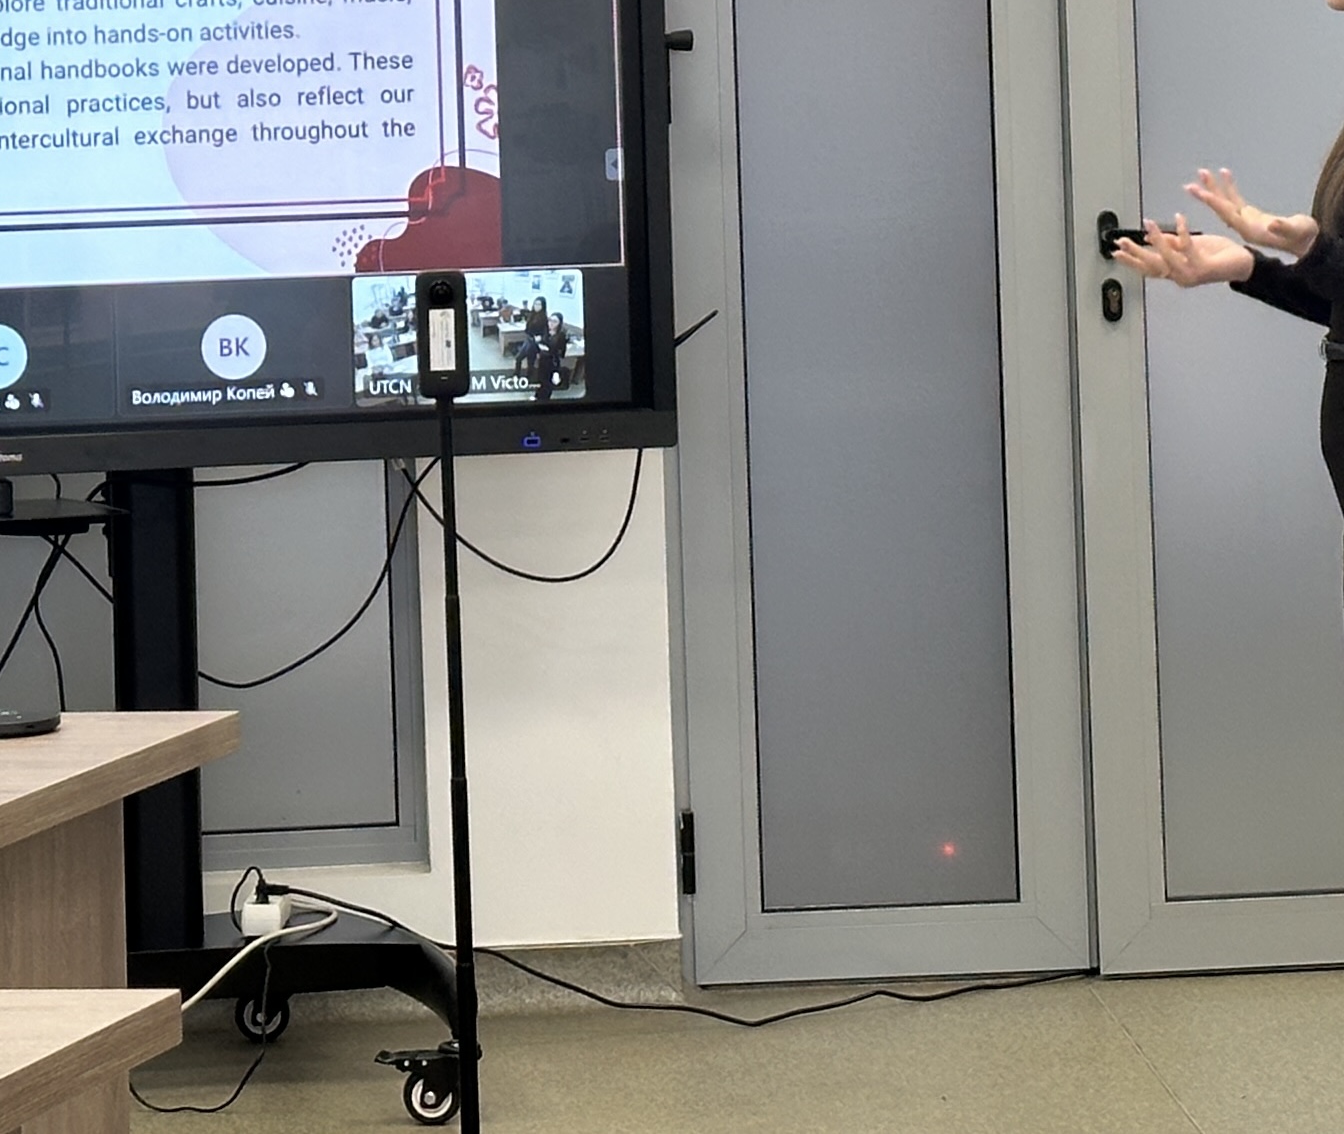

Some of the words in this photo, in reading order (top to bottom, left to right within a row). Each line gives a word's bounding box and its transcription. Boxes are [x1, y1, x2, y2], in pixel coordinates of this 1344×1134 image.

[47, 27, 87, 45] into
[94, 23, 192, 44] hands-on
[200, 21, 301, 41] activities.
[41, 57, 159, 80] handbooks
[167, 59, 219, 76] were
[227, 52, 341, 77] developed.
[348, 52, 413, 71] These
[67, 93, 170, 118] practices,
[187, 90, 221, 110] but
[237, 88, 281, 108] also
[298, 85, 364, 106] reflect
[381, 87, 414, 104] our
[134, 125, 237, 147] exchange
[252, 119, 368, 144] throughout
[382, 117, 415, 137] the
[131, 384, 222, 407] Володимир
[226, 382, 276, 402] Копей
[369, 379, 411, 395] UTCN
